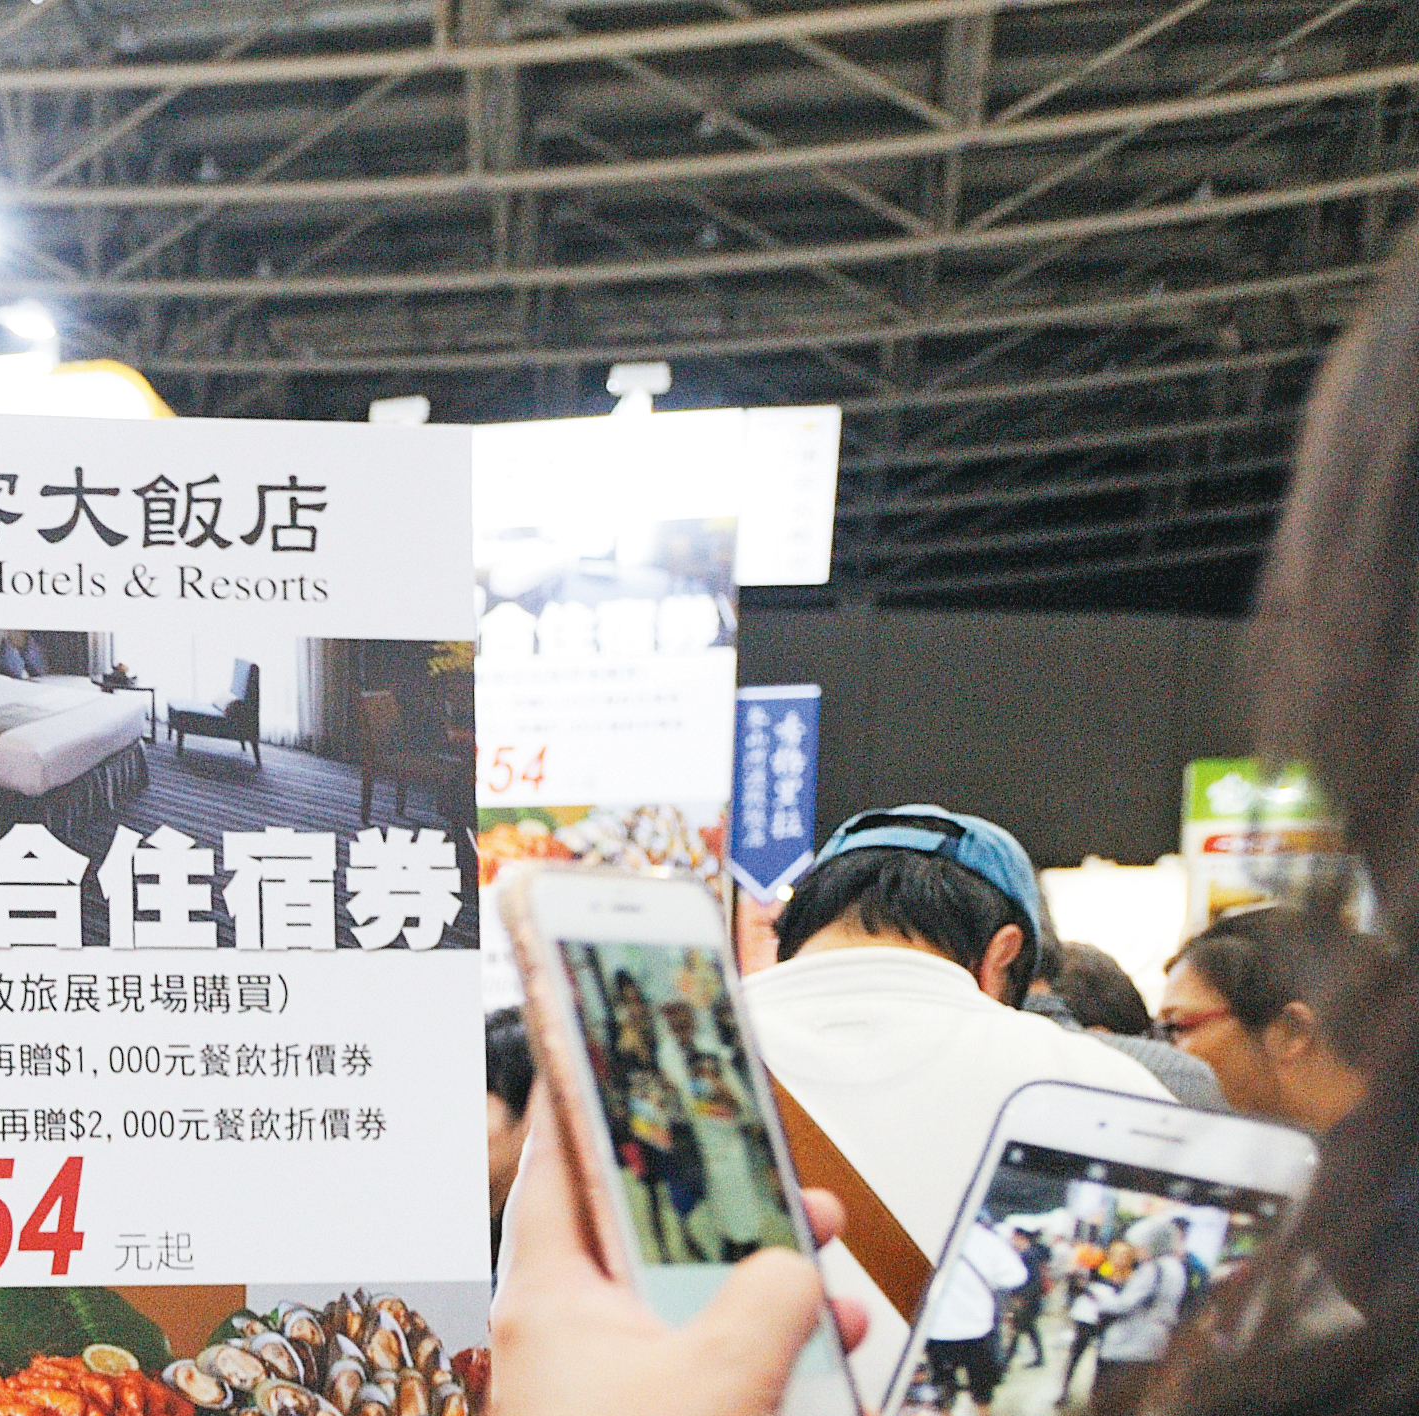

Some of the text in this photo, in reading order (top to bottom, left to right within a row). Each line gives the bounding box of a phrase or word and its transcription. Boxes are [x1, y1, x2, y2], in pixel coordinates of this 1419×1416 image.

[124, 569, 155, 598] &
[179, 566, 328, 601] Resorts
[475, 745, 548, 795] 54
[116, 1233, 194, 1271] 元起
